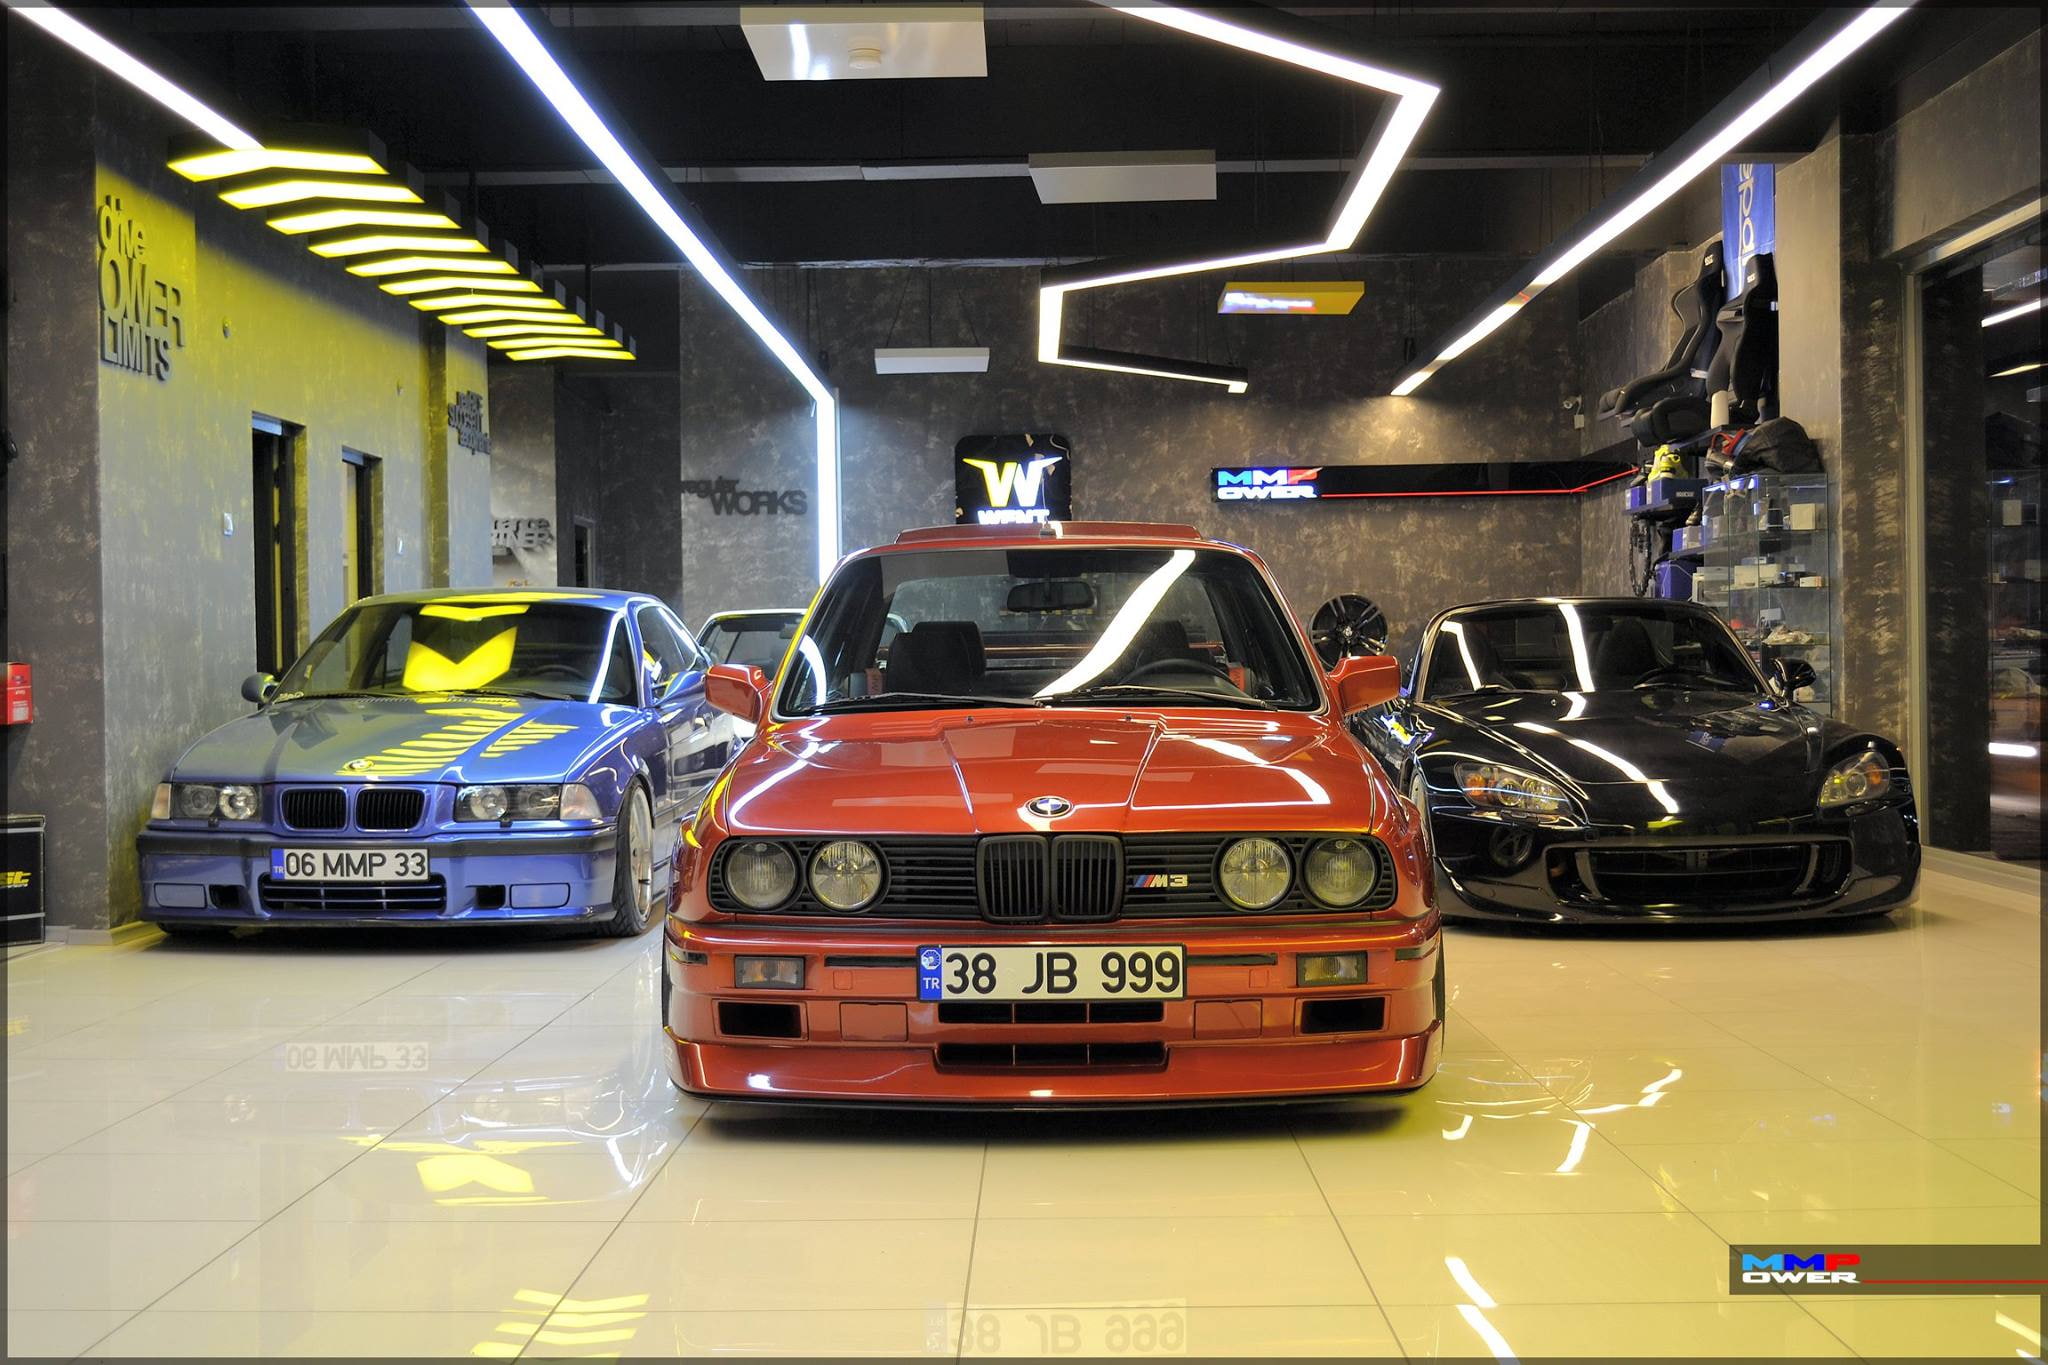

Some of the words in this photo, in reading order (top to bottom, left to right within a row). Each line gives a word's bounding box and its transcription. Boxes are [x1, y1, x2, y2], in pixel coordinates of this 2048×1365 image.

[100, 314, 172, 382] LIMITS
[1217, 468, 1318, 486] MMP
[1217, 486, 1318, 500] OWER
[710, 489, 808, 516] WORKS
[274, 866, 284, 874] TR
[286, 852, 316, 877] 06
[323, 852, 387, 877] MMP
[394, 852, 426, 877] 33
[1149, 874, 1189, 888] M3
[946, 952, 997, 994] 38
[1021, 952, 1078, 994] JB
[1101, 951, 1180, 994] 999
[923, 977, 940, 989] TR
